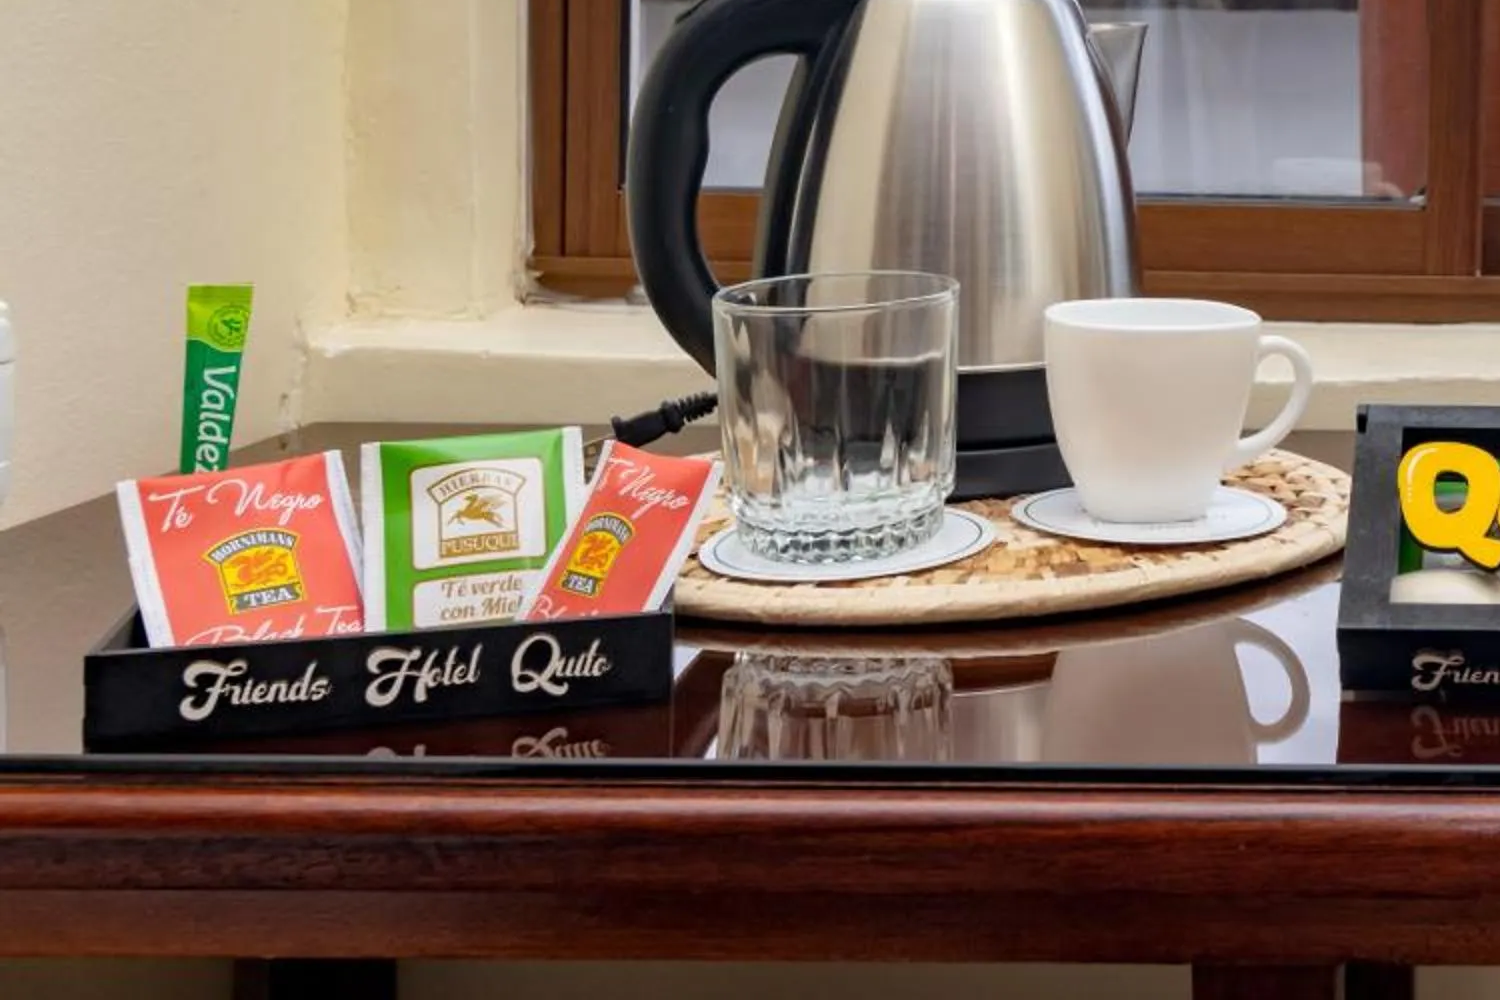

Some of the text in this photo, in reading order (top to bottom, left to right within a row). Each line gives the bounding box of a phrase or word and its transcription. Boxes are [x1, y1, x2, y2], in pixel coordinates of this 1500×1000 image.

[195, 366, 238, 474] Valdez
[207, 479, 324, 525] Negro
[618, 465, 690, 520] Negro
[243, 586, 293, 608] TEA
[472, 575, 523, 594] verde
[568, 573, 597, 594] TEA
[315, 605, 363, 636] Tea
[440, 604, 475, 620] con
[481, 596, 525, 617] Miel
[179, 633, 612, 721] Friends Hotel Quito
